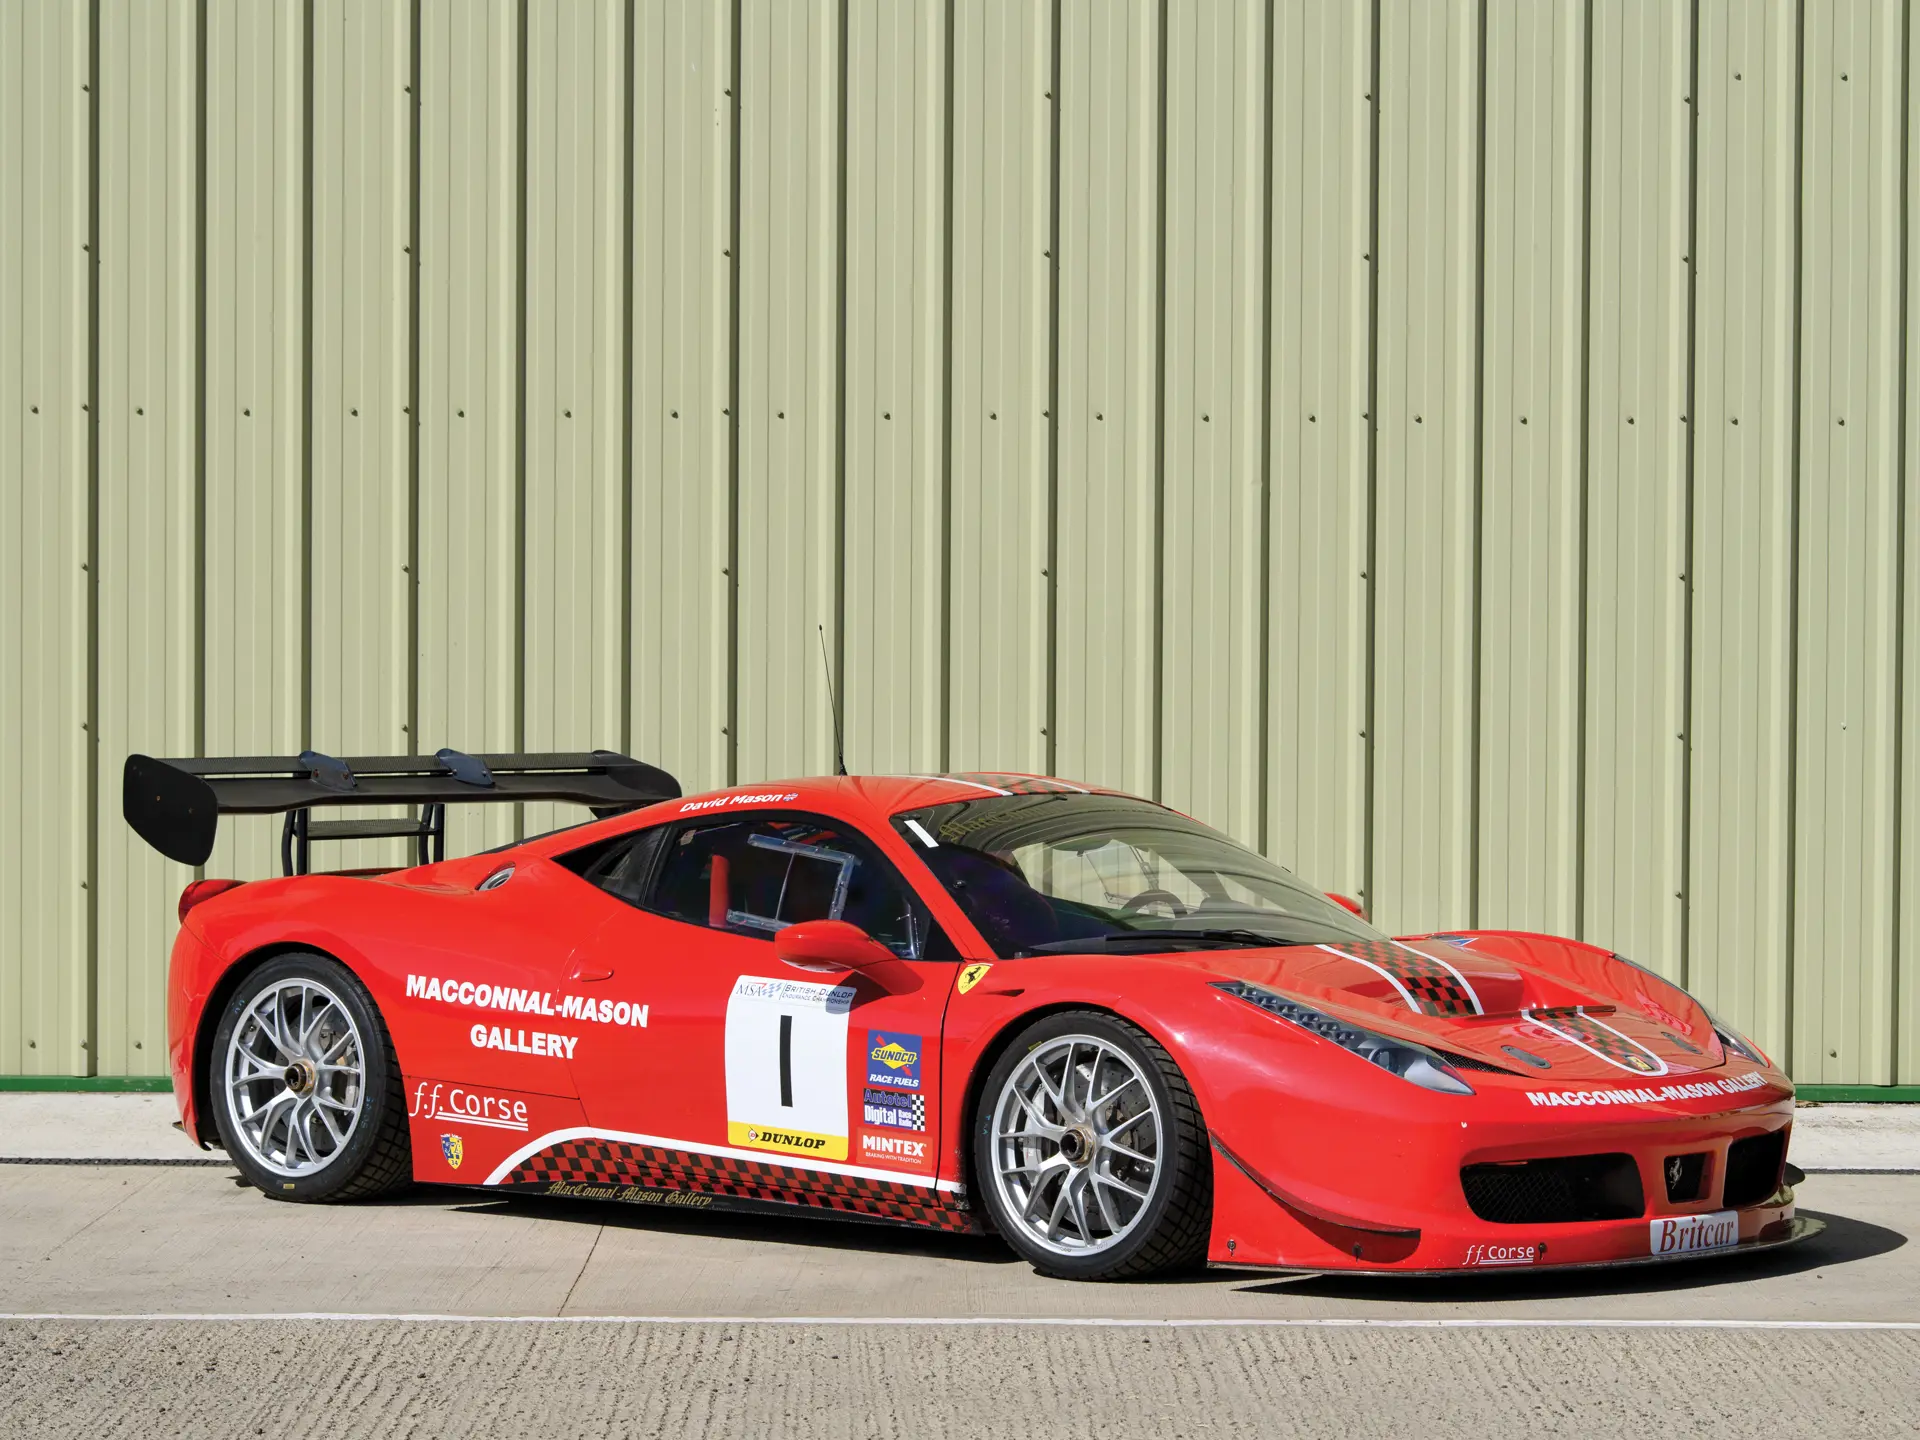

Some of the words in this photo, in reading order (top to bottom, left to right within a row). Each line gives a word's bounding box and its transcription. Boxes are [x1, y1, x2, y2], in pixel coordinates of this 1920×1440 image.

[679, 796, 730, 813] David
[729, 793, 783, 805] Mason
[405, 974, 650, 1028] MACCONNAL-MASON
[784, 984, 817, 995] BRITISH
[819, 988, 854, 999] DUNLOP
[470, 1024, 579, 1060] GALLERY
[873, 1049, 916, 1064] SUNOCO
[869, 1073, 894, 1084] RACE
[893, 1076, 920, 1088] FUELS
[1525, 1082, 1725, 1107] MACCONNAL-MASON
[1716, 1071, 1769, 1094] GALLERY
[449, 1088, 529, 1123] Corse
[864, 1088, 912, 1108] Autotel
[864, 1104, 897, 1125] Digital
[760, 1131, 826, 1149] DUNLOP
[862, 1134, 925, 1158] MINTEX
[665, 1190, 713, 1208] Gallery
[1659, 1216, 1735, 1253] Britcar
[1488, 1245, 1535, 1260] Corse
